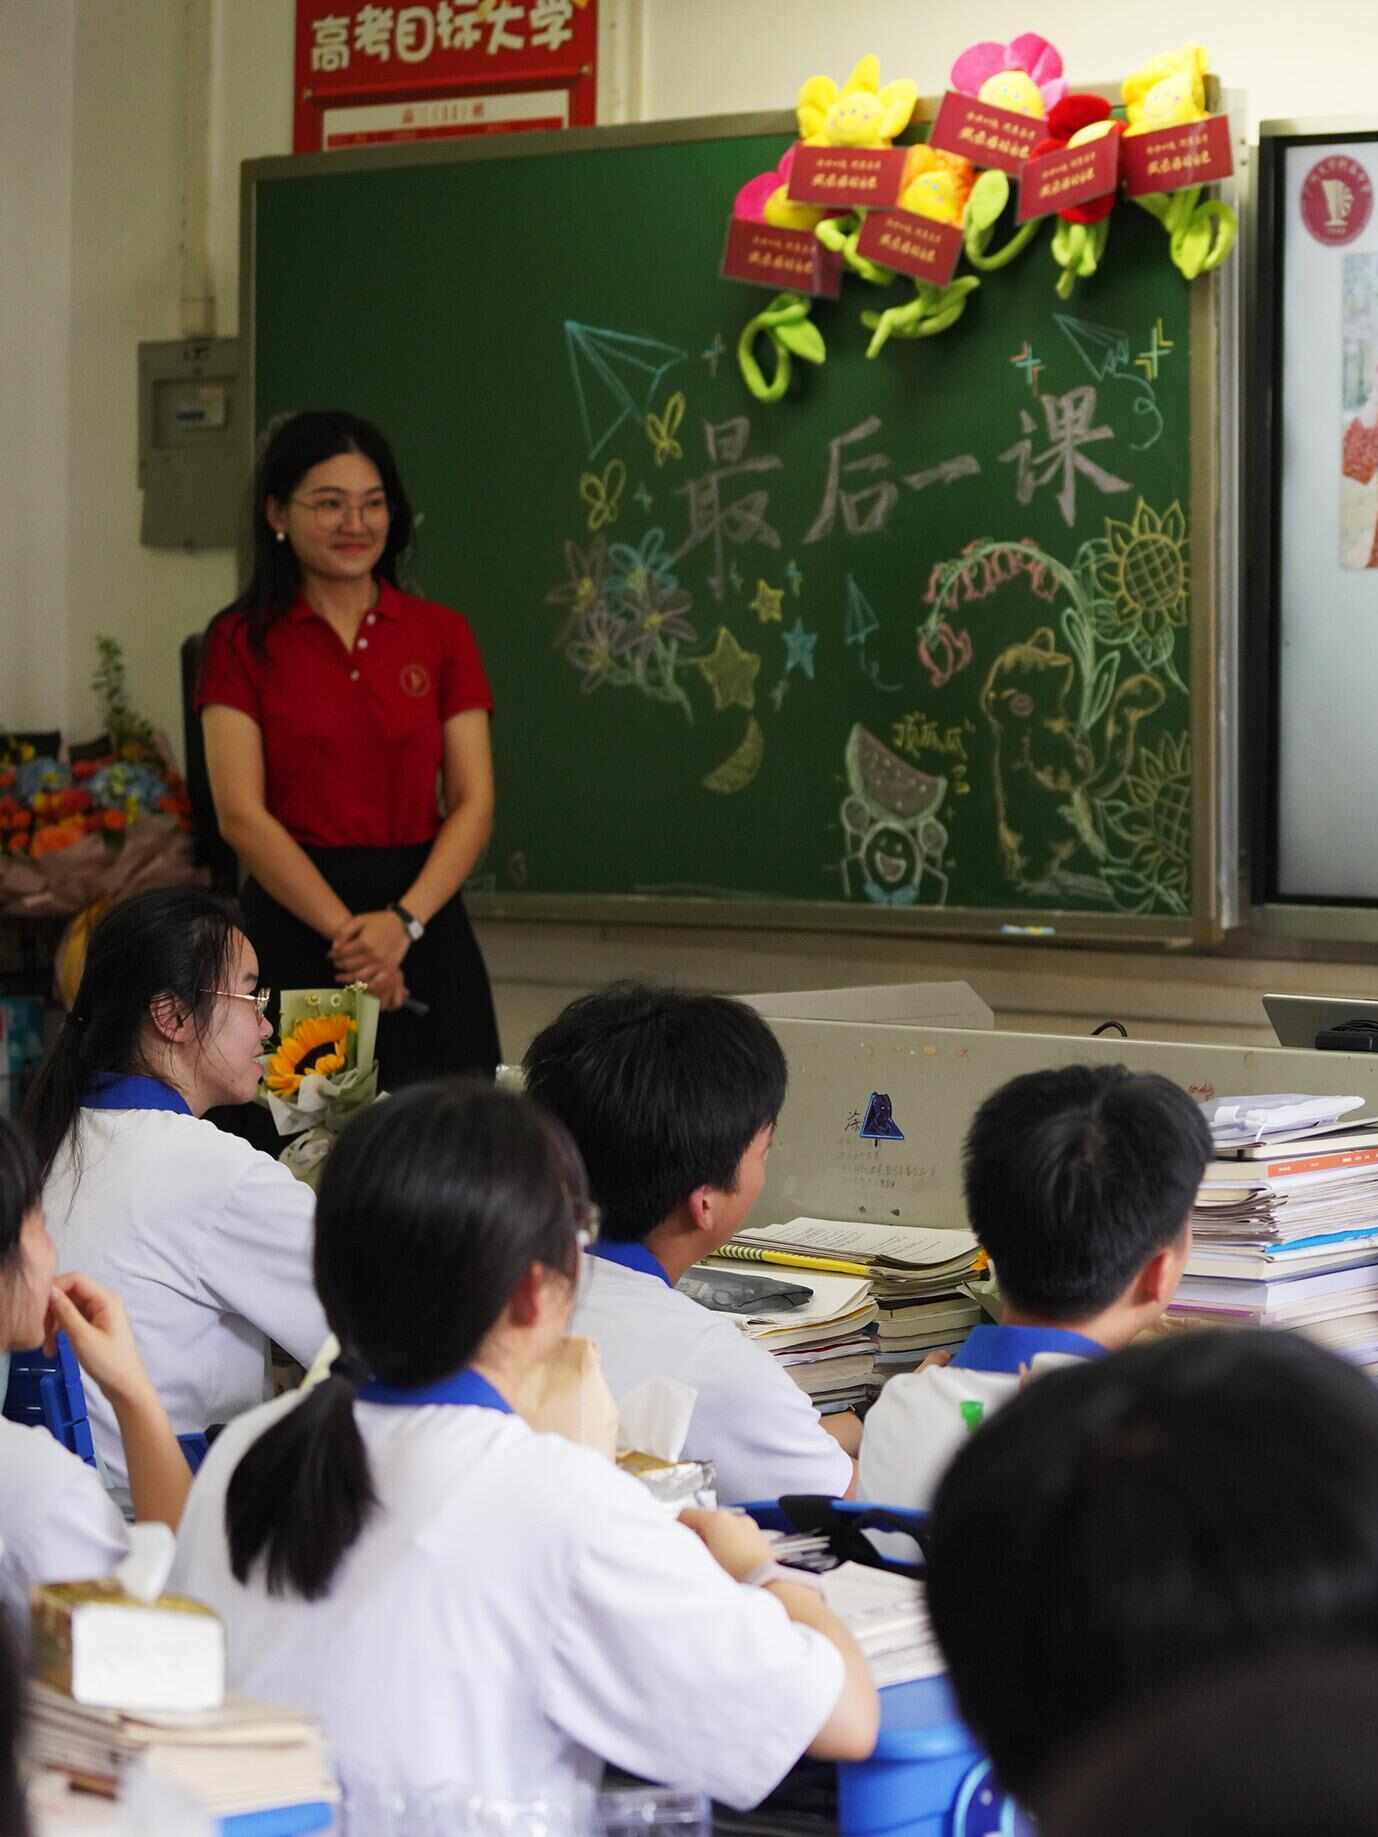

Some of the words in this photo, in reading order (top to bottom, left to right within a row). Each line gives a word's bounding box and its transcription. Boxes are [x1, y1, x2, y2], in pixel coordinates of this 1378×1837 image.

[311, 0, 573, 72] 高考目标大学
[672, 385, 1134, 598] 最后一课
